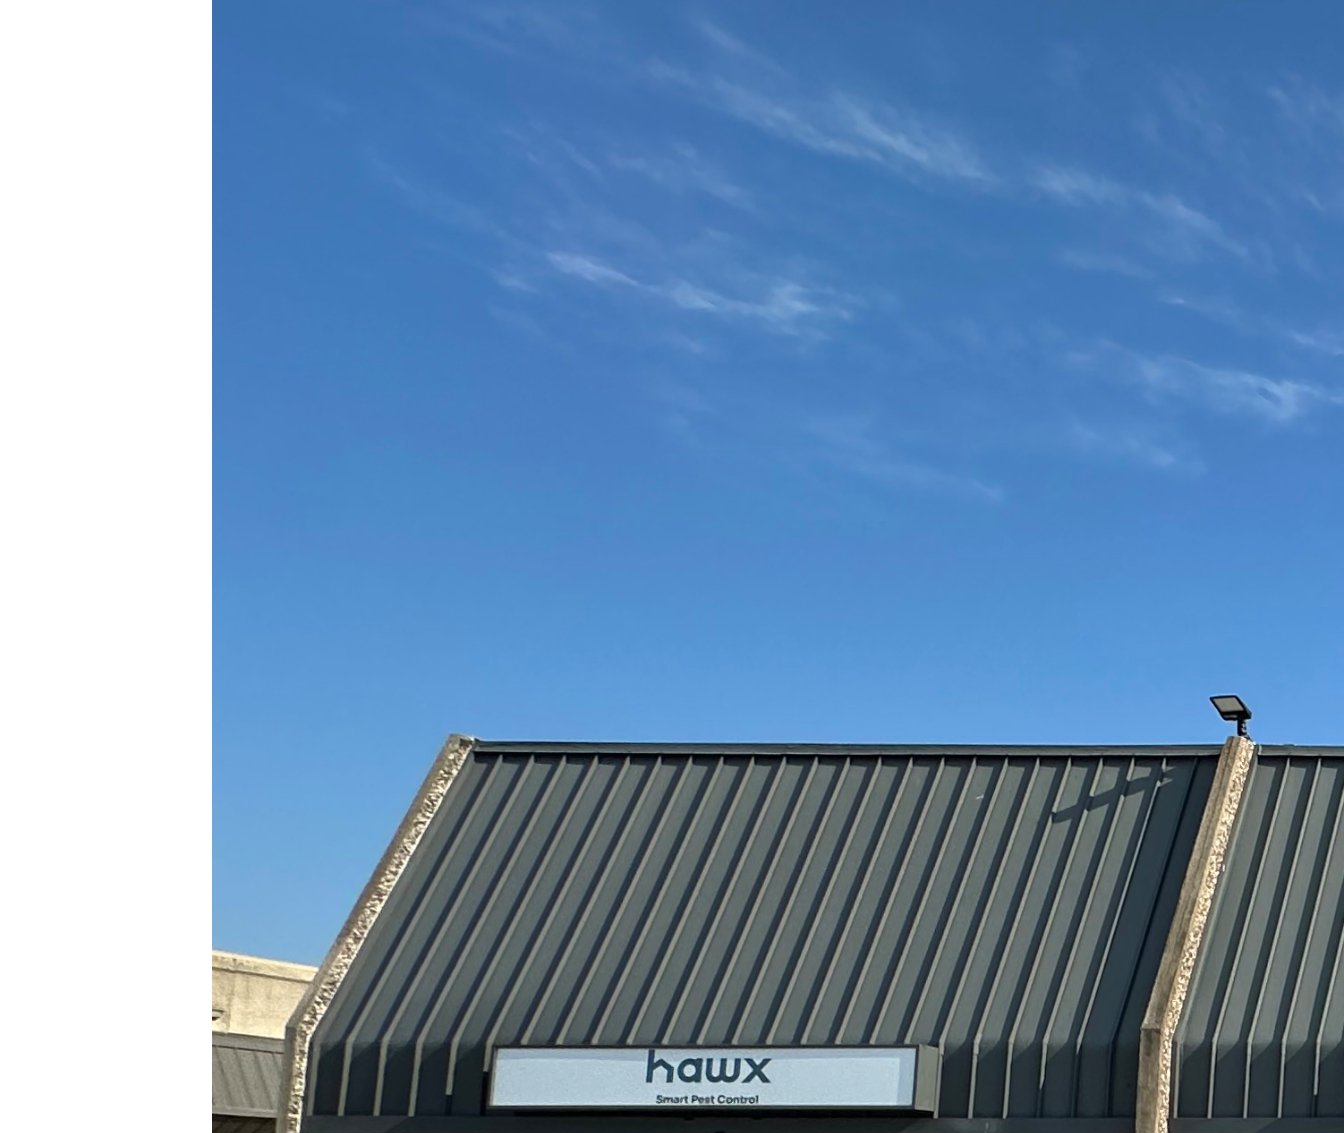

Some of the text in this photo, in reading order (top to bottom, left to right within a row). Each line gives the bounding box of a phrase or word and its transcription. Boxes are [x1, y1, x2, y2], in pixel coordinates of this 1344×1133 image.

[646, 1049, 773, 1083] hawx
[655, 1094, 760, 1104] Smart Pest Control
